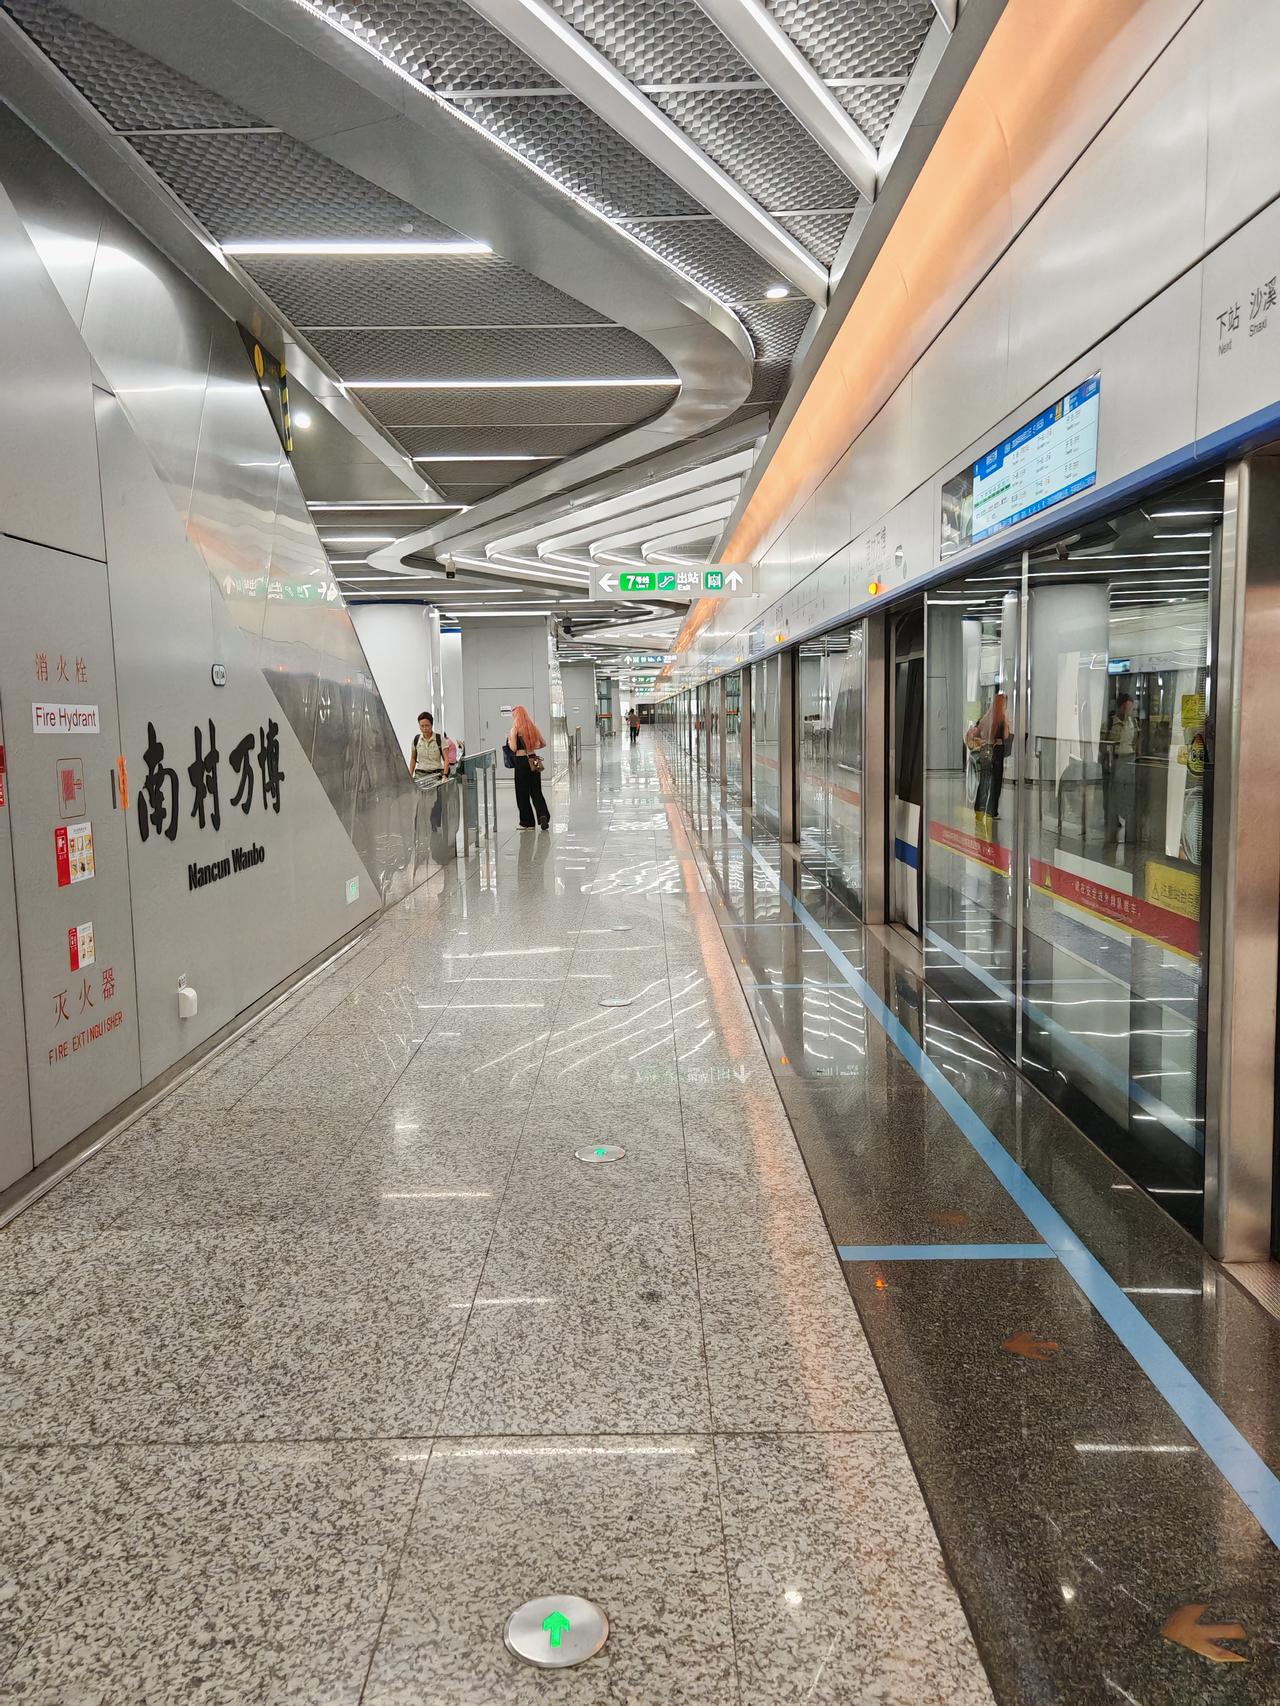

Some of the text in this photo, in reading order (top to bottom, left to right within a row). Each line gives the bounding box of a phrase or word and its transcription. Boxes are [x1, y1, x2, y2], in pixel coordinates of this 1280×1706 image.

[1215, 276, 1277, 340] 下站 沙溪
[676, 571, 699, 584] 出站
[34, 652, 89, 684] 消火栓
[35, 706, 97, 731] Fire Hydrant
[136, 716, 286, 843] 南村万博
[188, 842, 265, 891] Nancun Wanbo
[52, 966, 116, 1029] 灭火器
[48, 1010, 123, 1066] FIRE EXTINGUISHER
